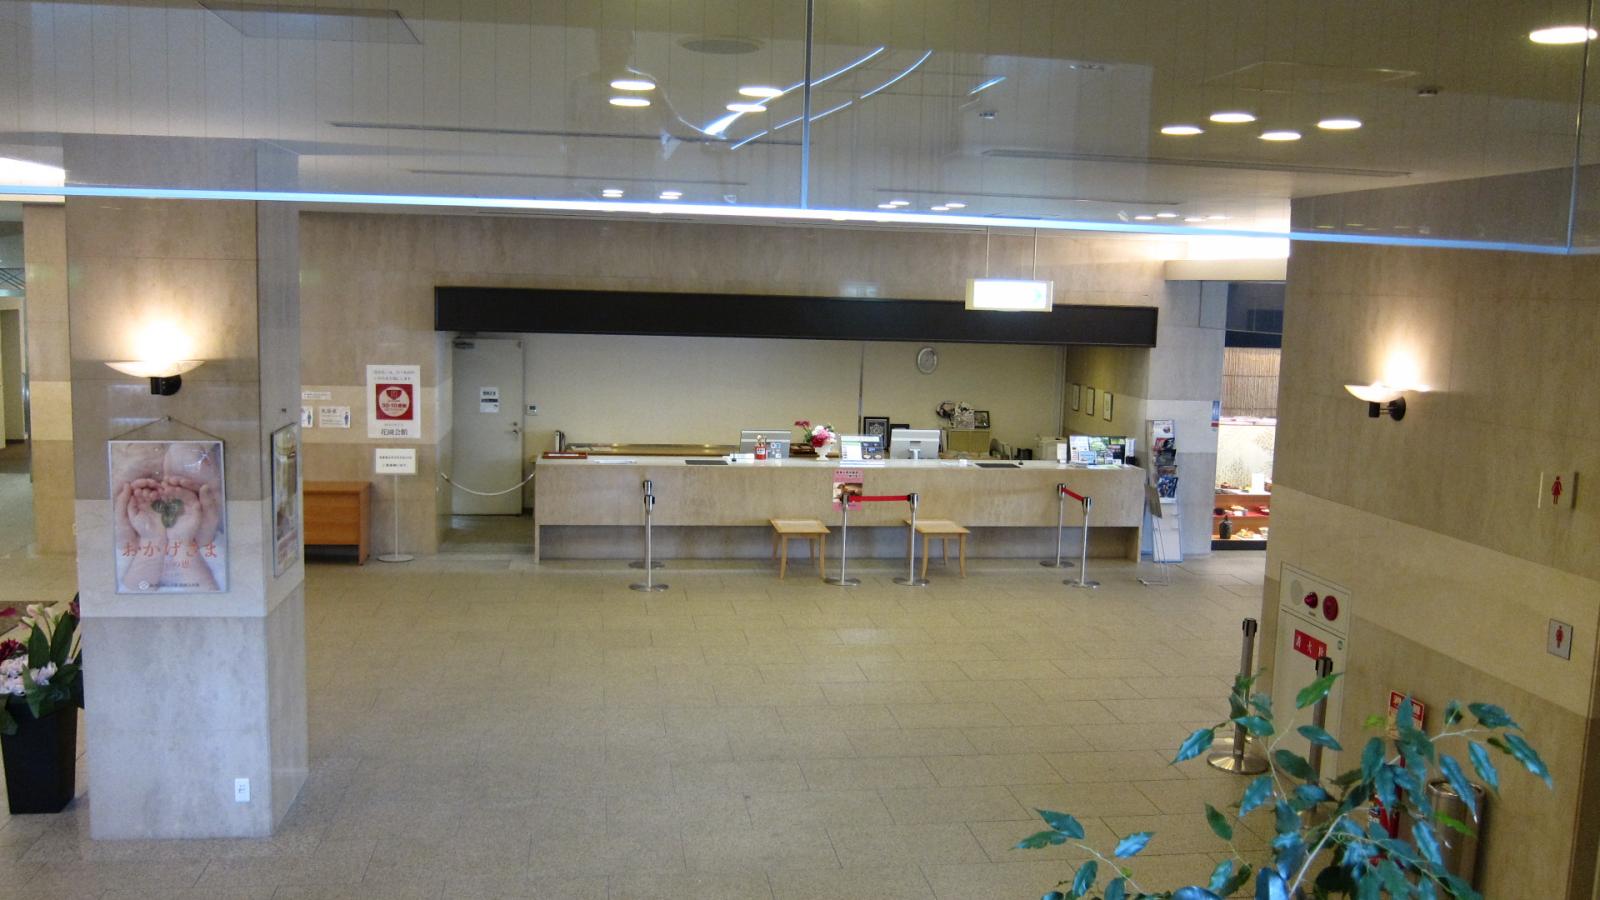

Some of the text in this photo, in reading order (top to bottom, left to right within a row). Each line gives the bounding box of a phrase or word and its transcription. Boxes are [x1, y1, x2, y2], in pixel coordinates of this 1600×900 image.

[122, 540, 217, 558] おかげさま
